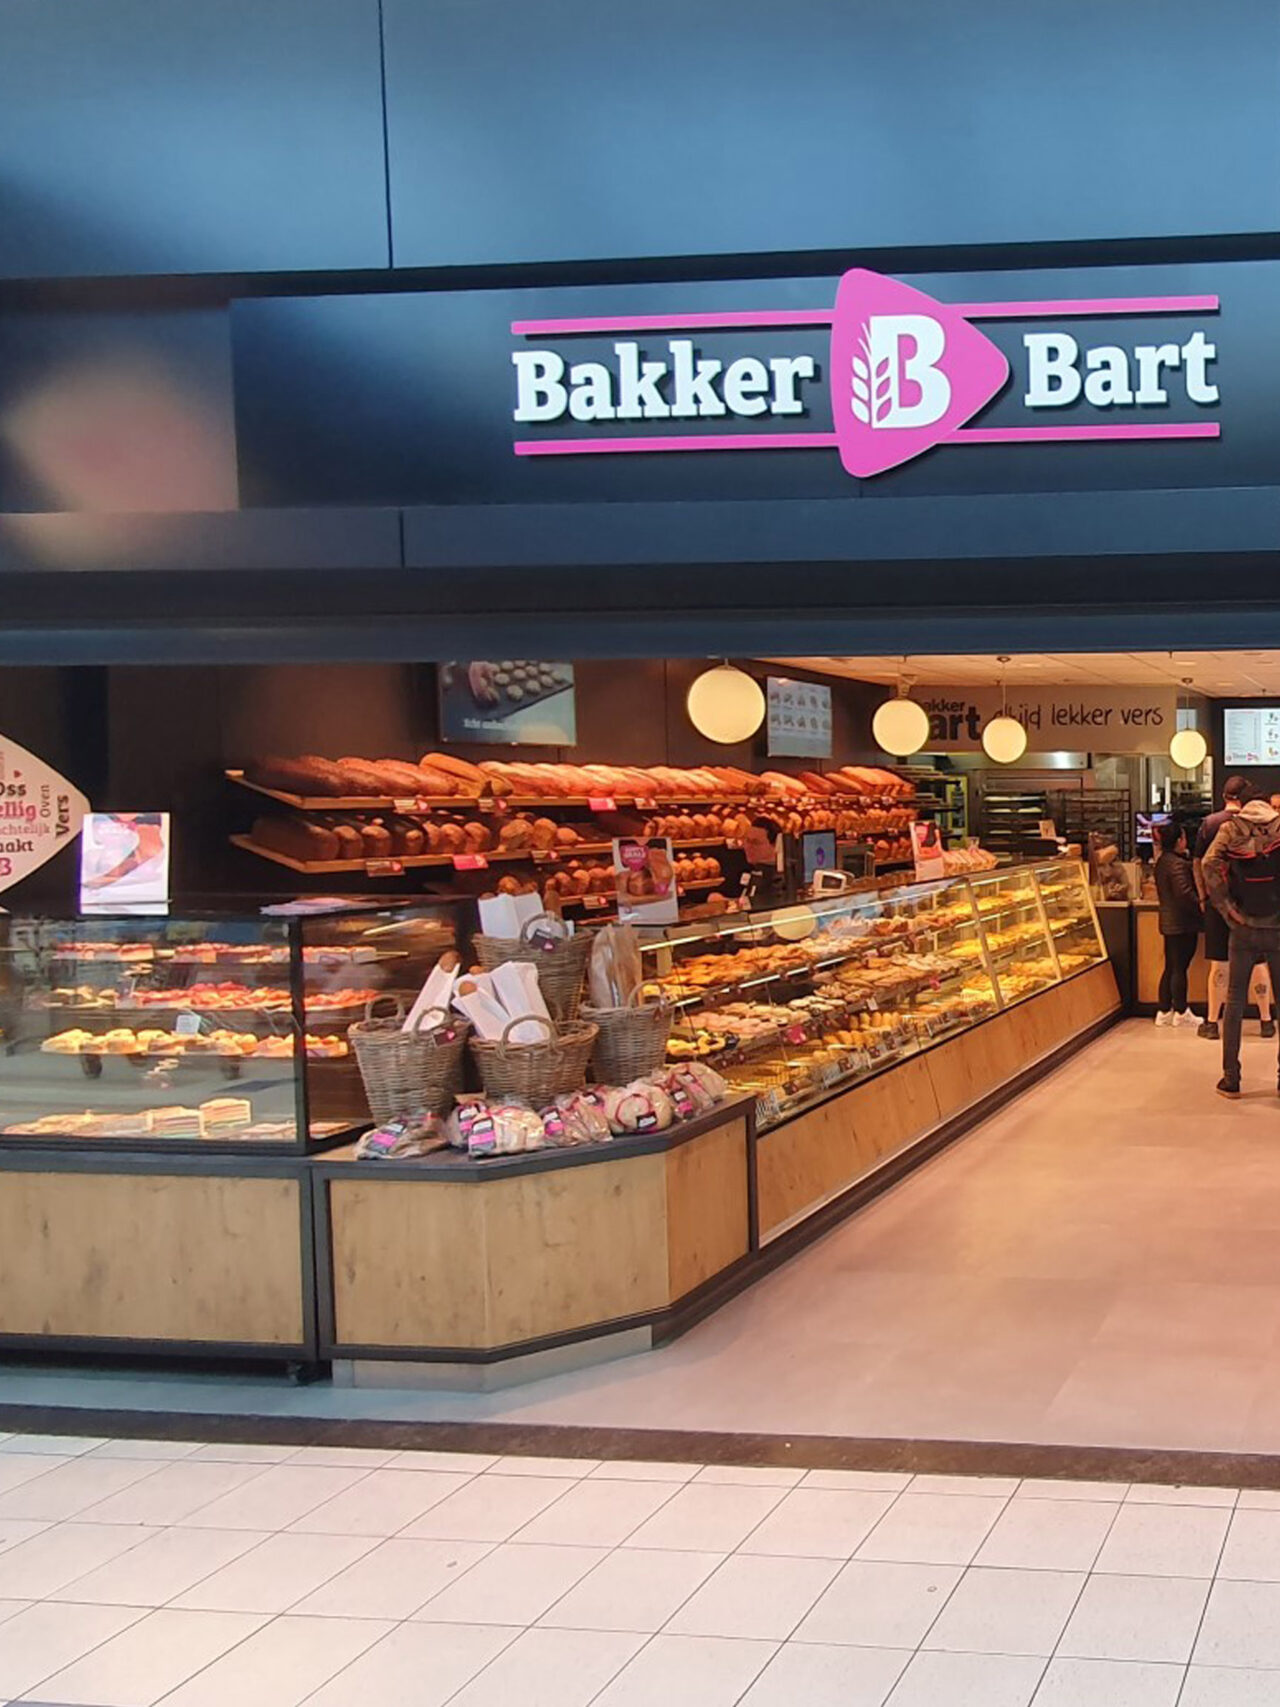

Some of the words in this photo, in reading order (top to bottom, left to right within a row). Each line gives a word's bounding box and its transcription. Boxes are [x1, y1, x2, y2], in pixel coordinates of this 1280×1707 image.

[512, 340, 814, 422] Bakker
[852, 315, 952, 429] B
[1023, 332, 1219, 407] Bart
[924, 698, 966, 712] akker
[928, 706, 981, 741] art
[1051, 704, 1113, 726] lekker
[1121, 706, 1163, 726] vers
[40, 784, 51, 818] Oven
[55, 795, 70, 839] Vers
